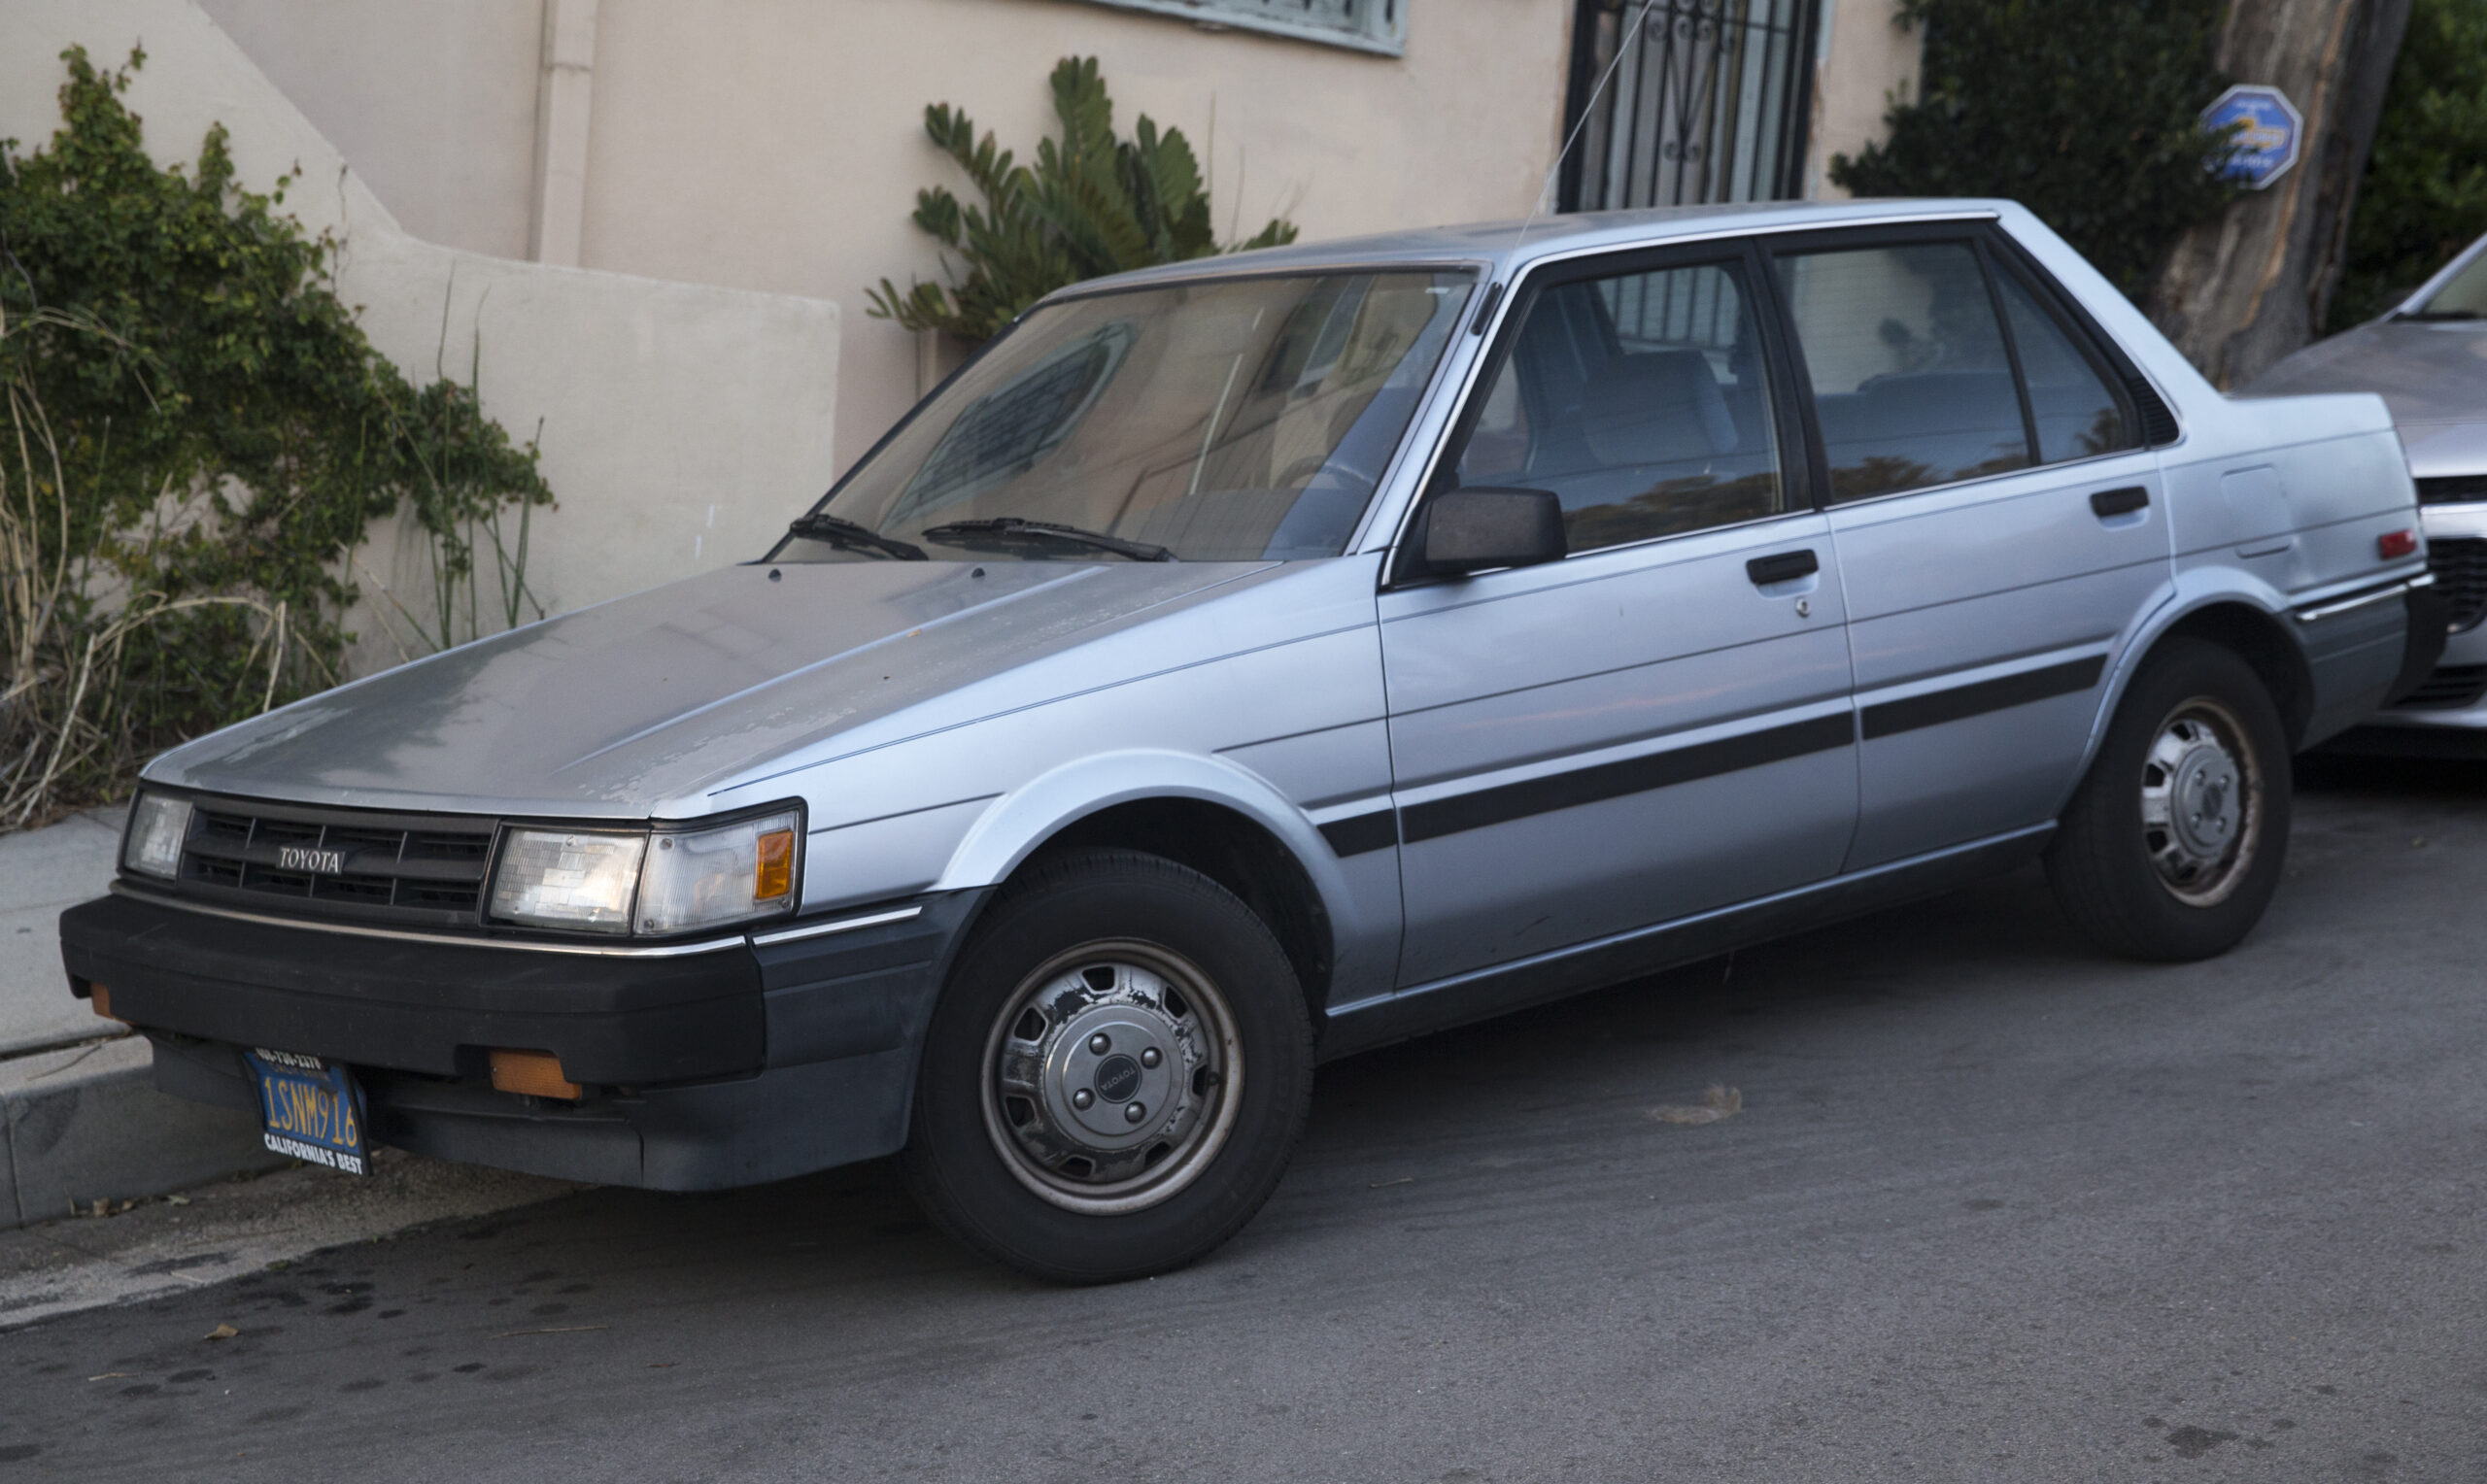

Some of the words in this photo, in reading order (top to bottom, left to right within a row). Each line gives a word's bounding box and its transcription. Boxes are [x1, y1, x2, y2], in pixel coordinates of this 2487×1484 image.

[281, 847, 338, 873] TOYOTA
[1101, 1066, 1136, 1091] TOYOTA
[264, 1077, 358, 1147] 1SNM916
[264, 1133, 335, 1167] CALIFORNIA'S
[337, 1153, 362, 1175] BEST
